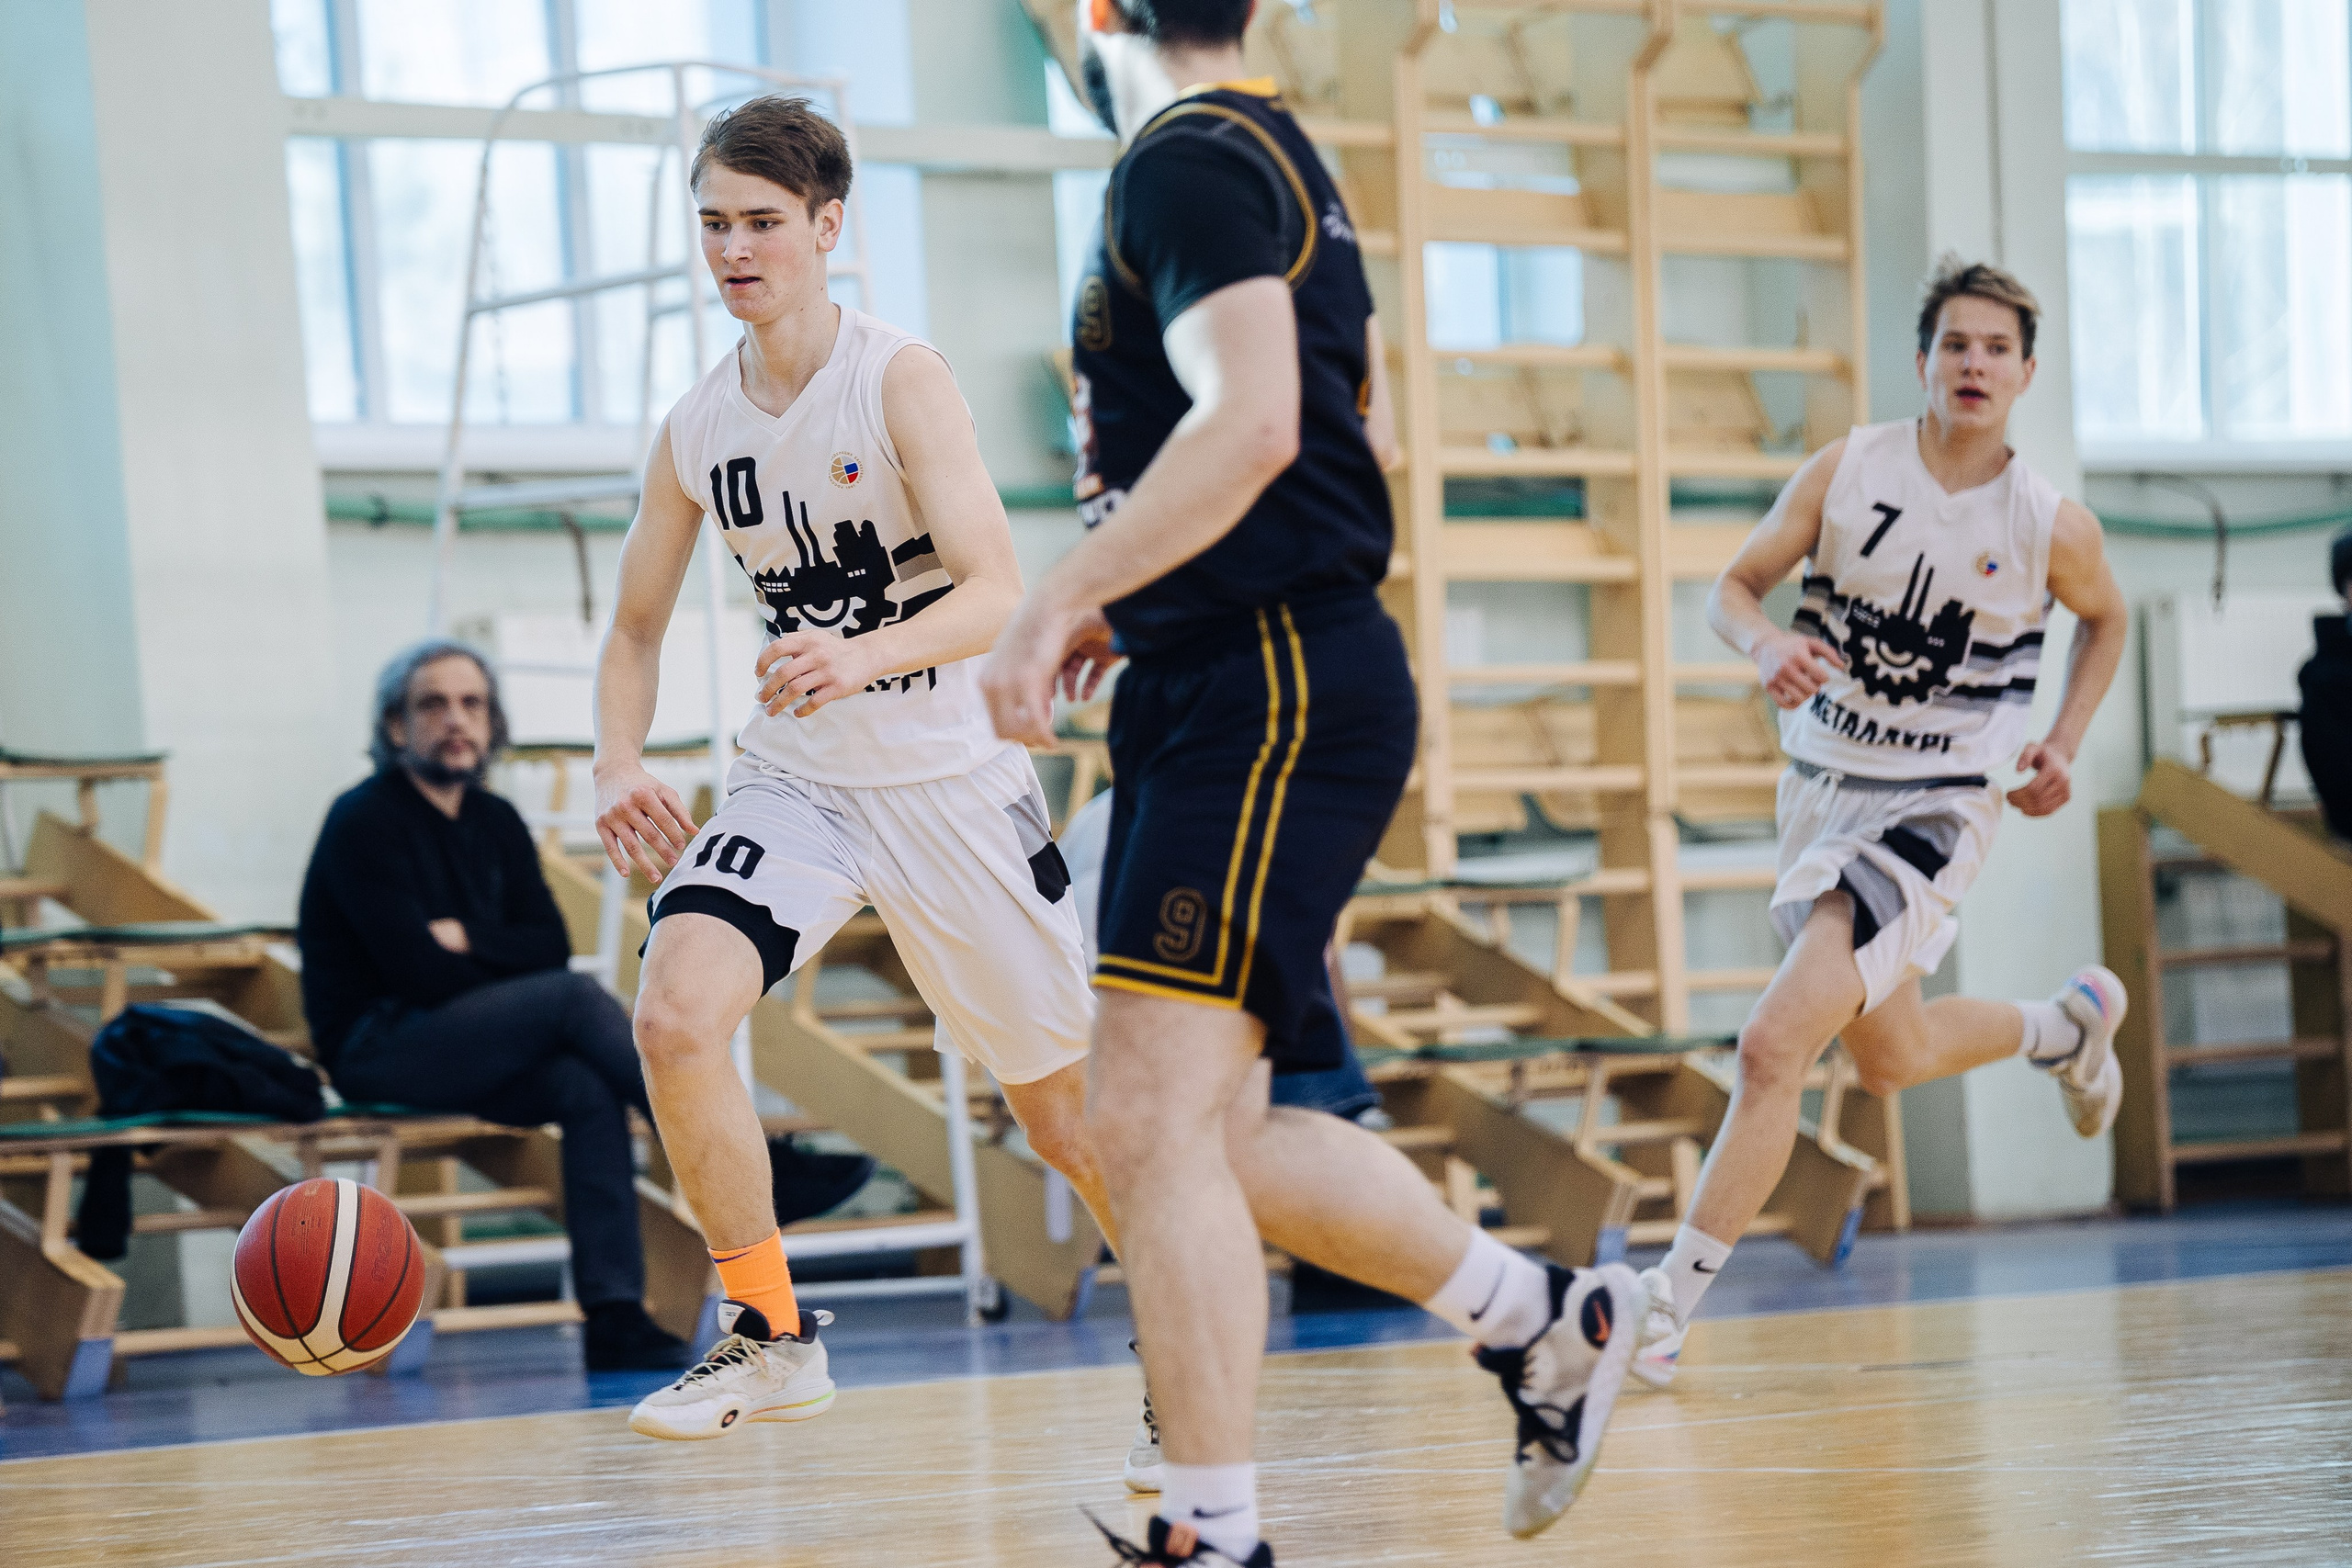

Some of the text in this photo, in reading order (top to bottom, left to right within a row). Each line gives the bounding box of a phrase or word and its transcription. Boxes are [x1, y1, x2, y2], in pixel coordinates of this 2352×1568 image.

[709, 456, 764, 530] 10
[1860, 502, 1904, 558] 7
[692, 831, 766, 880] 10
[1153, 886, 1208, 963] 9
